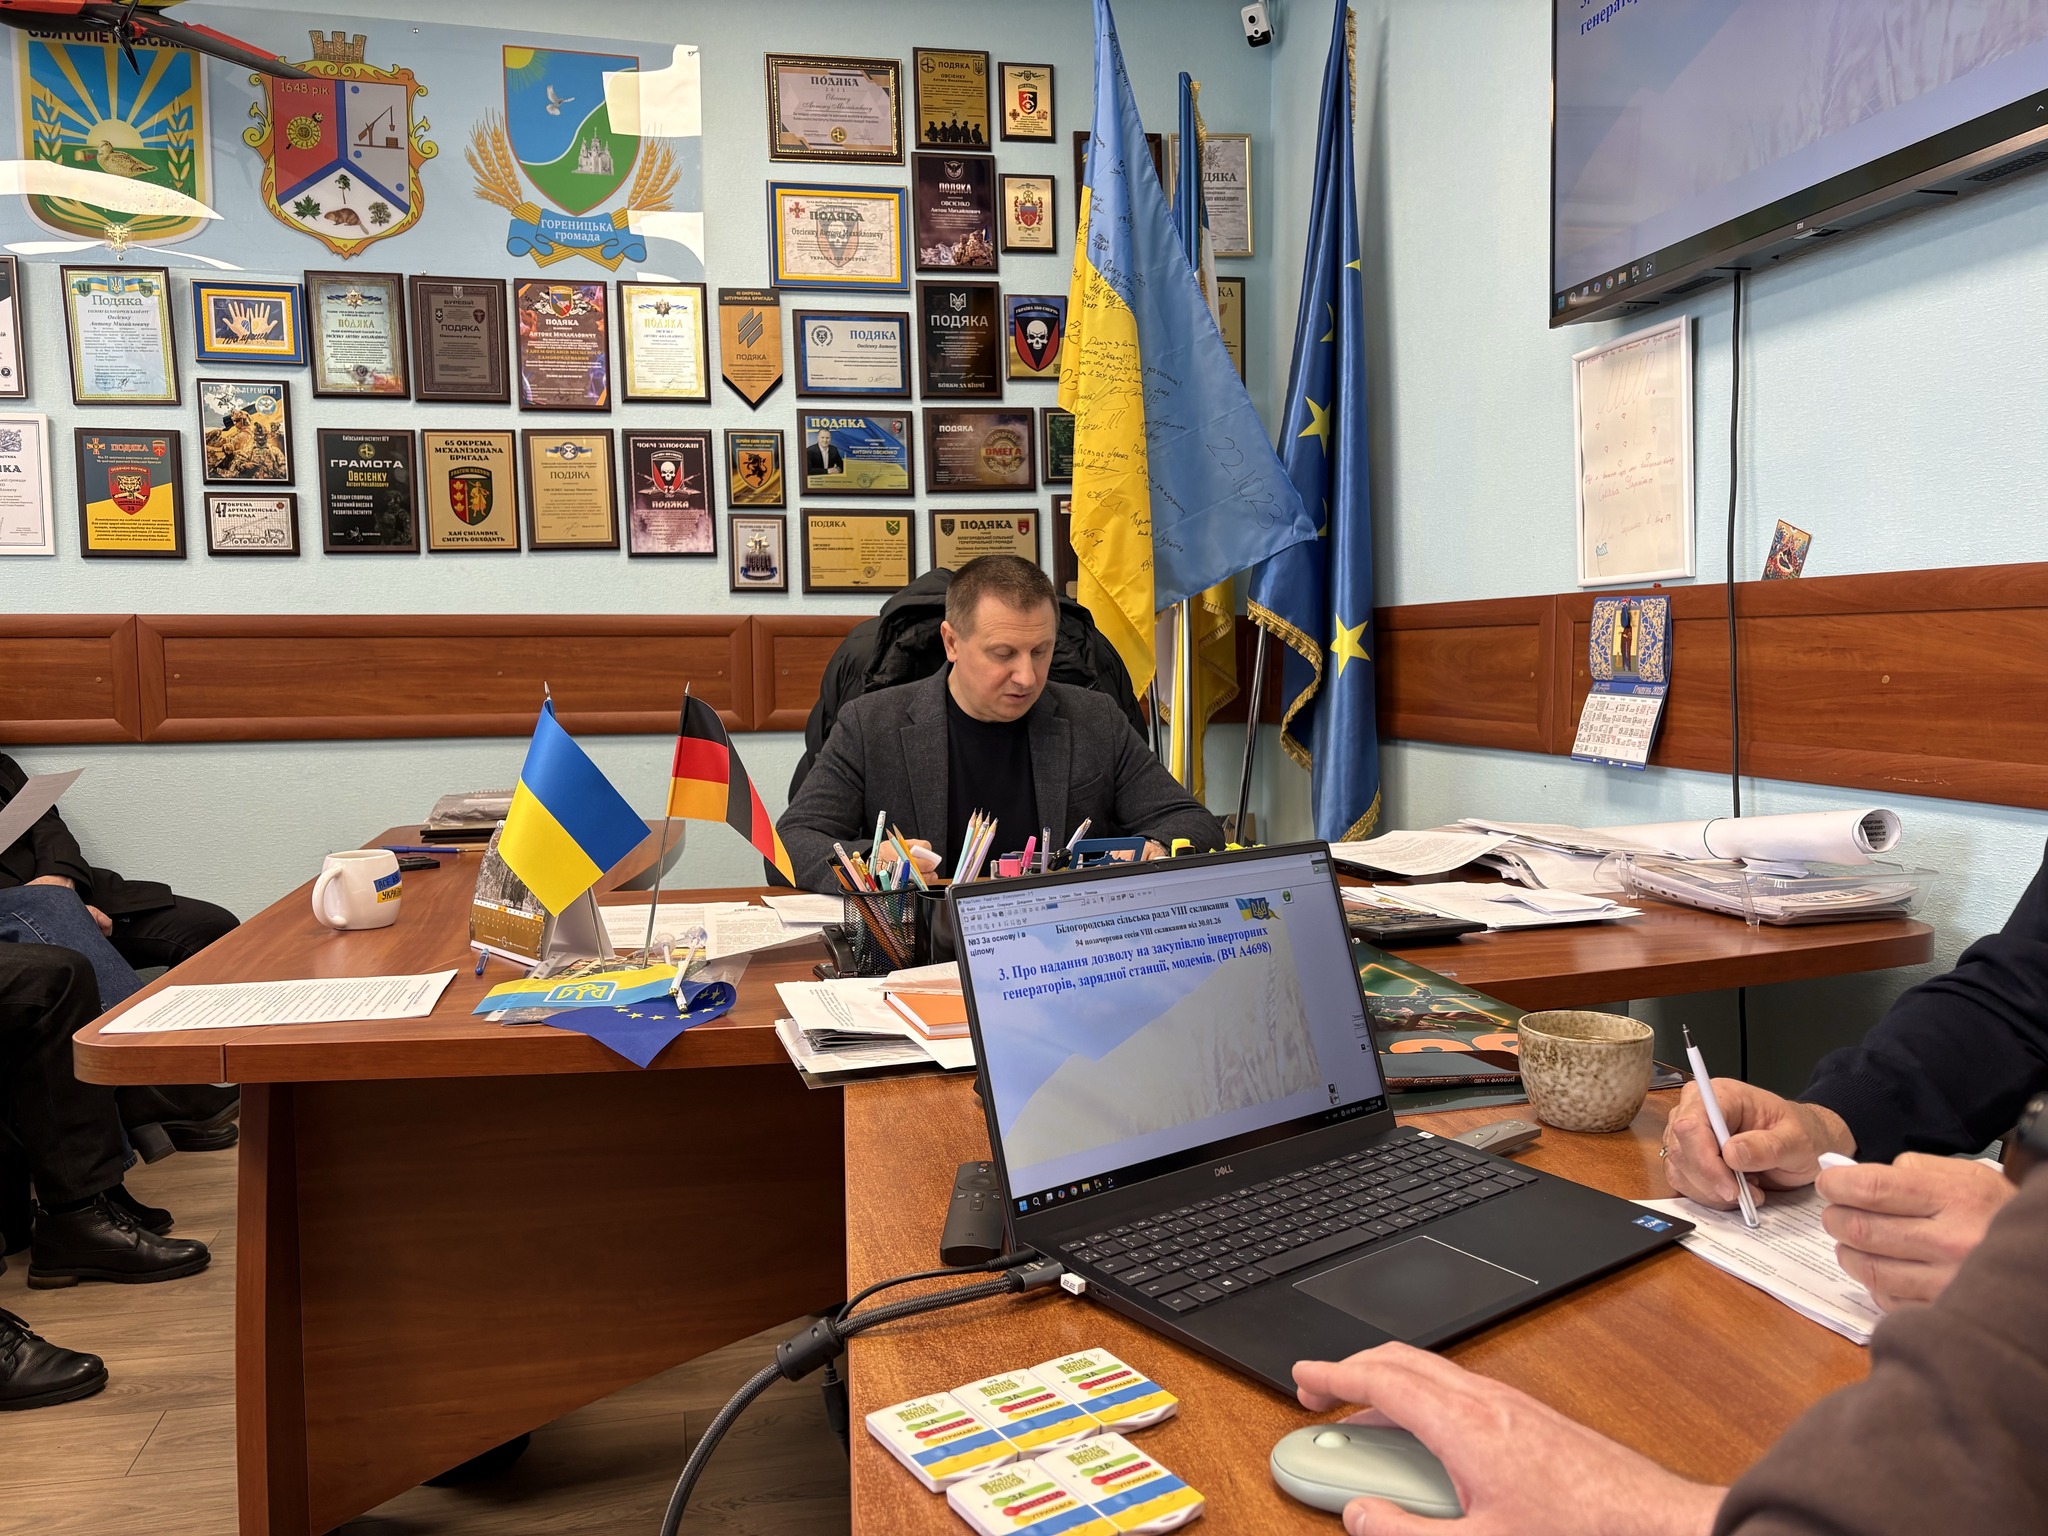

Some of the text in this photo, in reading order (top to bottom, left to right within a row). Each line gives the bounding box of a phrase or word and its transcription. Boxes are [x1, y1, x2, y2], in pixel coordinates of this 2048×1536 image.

[938, 61, 970, 70] ПОДЯКА
[810, 76, 859, 87] ПОДЯКА
[281, 81, 330, 96] 1648 рік
[1203, 172, 1237, 183] ДЯКА
[938, 182, 972, 194] ПОДЯКА
[810, 211, 864, 222] ПОДЯКА
[541, 218, 614, 233] ГОРЕНИЦЬКА
[555, 231, 600, 243] громада
[92, 295, 143, 307] Подяка
[338, 320, 375, 329] ПОДЯКА
[546, 319, 579, 327] ПОДЯКА
[644, 318, 683, 328] ПОДЯКА
[930, 315, 988, 328] ПОДЯКА
[441, 324, 480, 332] ПОДЯКА
[850, 330, 896, 342] ПОДЯКА
[811, 418, 866, 429] ПОДЯКА
[110, 444, 149, 452] ПОДЯКА
[985, 448, 1022, 456] ОМЕГА
[330, 460, 403, 468] ГРАМОТА
[550, 471, 590, 480] ПОДЯКА
[215, 502, 226, 518] 47
[652, 501, 689, 509] ПОДЯКА
[960, 520, 1013, 530] ПОДЯКА
[1055, 901, 1229, 934] Білогородська сільська рада VIII скликання
[1075, 938, 1084, 948] 94
[1084, 933, 1123, 945] позачергова
[1124, 930, 1139, 940] сесія
[1154, 923, 1187, 934] скликання
[1188, 921, 1198, 929] від
[1198, 916, 1222, 928] 30.01.26
[982, 936, 991, 944] За
[992, 934, 1016, 944] основу
[970, 946, 995, 957] цілому
[998, 926, 1268, 981] 3. Про надання дозволу на закупівлю інверторних
[1002, 941, 1272, 1001] генераторів, зарядної станції, модемів. (ВЧ А4698)
[1214, 1164, 1233, 1177] DELL
[921, 1418, 937, 1427] ЗА
[1095, 1463, 1112, 1471] ЗА
[1010, 1493, 1025, 1501] ЗА
